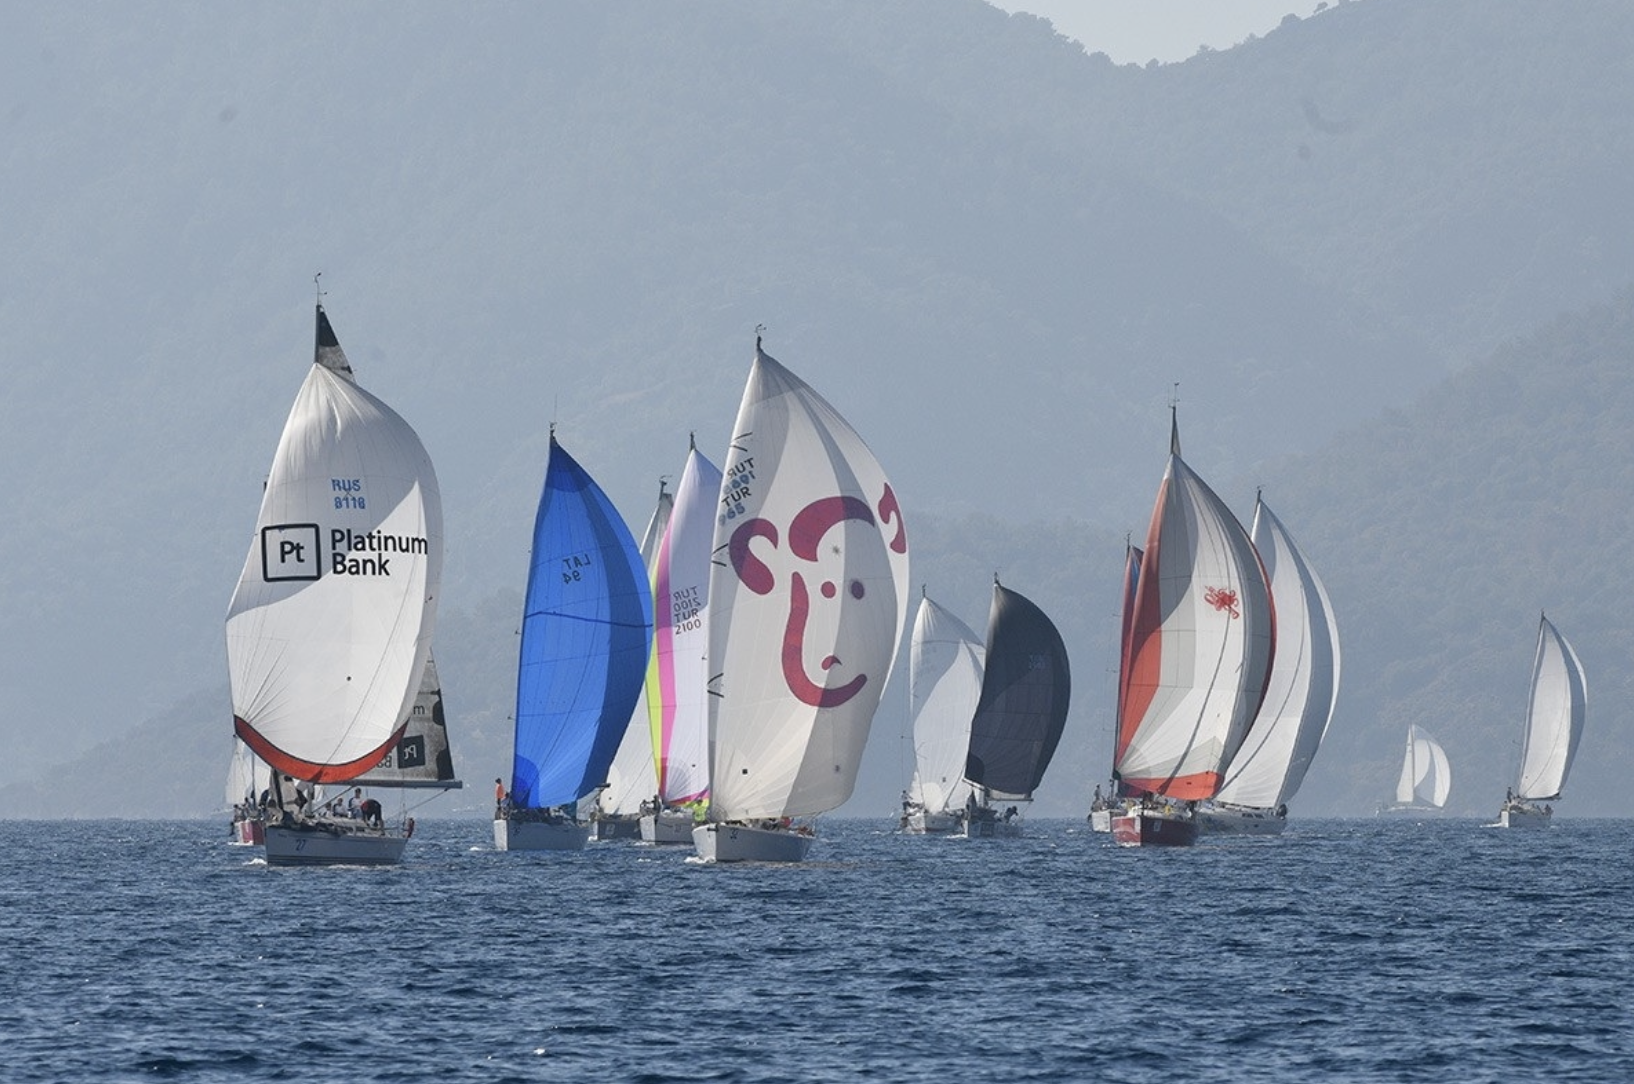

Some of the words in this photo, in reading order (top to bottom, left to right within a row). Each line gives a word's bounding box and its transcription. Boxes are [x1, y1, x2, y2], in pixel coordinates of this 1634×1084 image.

[331, 479, 360, 491] RUS
[721, 486, 752, 507] TUR
[279, 540, 305, 563] Pt
[331, 528, 428, 555] Platinum
[332, 552, 390, 576] Bank
[674, 608, 698, 623] TUR
[675, 618, 701, 635] 2100
